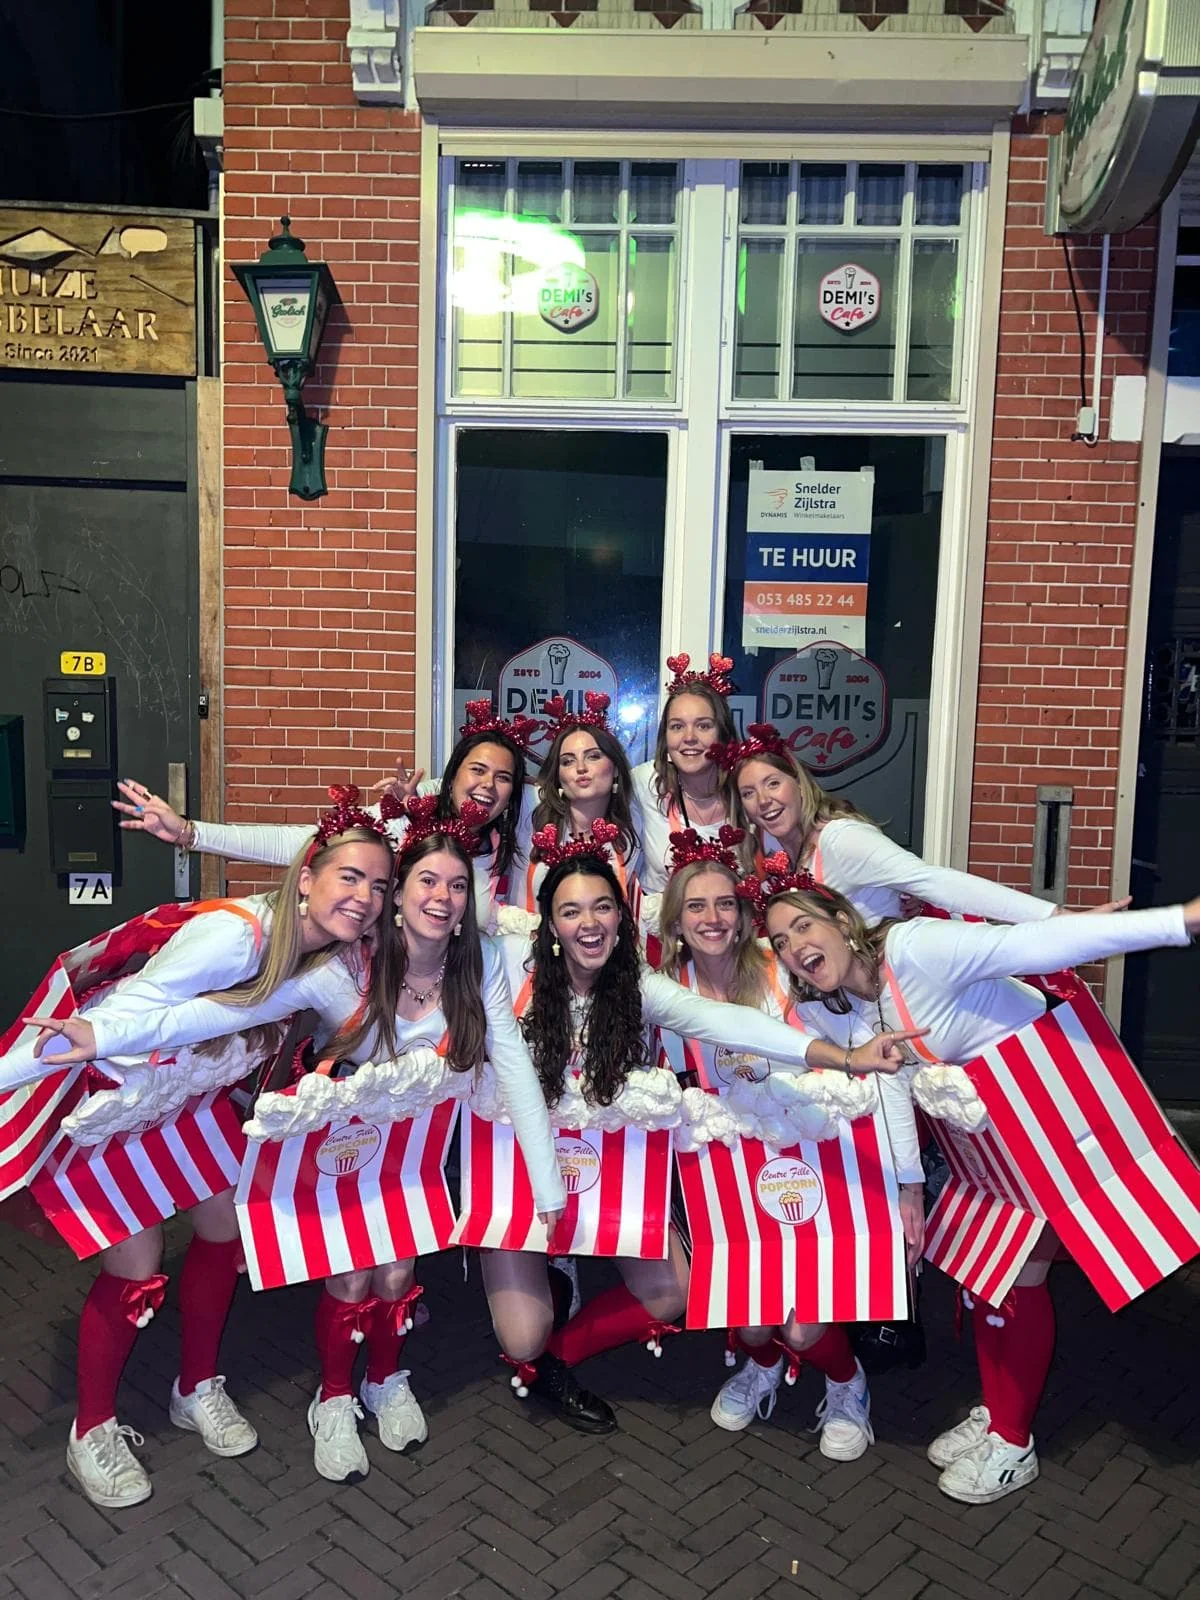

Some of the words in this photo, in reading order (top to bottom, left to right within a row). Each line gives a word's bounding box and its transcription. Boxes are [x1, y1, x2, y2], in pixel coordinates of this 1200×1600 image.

[541, 288, 593, 303] DEMI's
[823, 290, 875, 305] DEMI's
[0, 302, 159, 340] BELAAR
[4, 342, 54, 361] Since
[58, 344, 99, 363] 2021
[794, 482, 842, 495] Snelder
[794, 497, 836, 512] Zijlstra
[758, 547, 786, 567] TE
[791, 547, 857, 568] HUUR
[756, 593, 783, 606] 053
[786, 593, 812, 606] 485
[816, 594, 833, 606] 22
[837, 594, 855, 607] 44
[755, 624, 828, 636] snelderzijlstra.nl
[72, 656, 94, 672] 7B
[513, 668, 541, 678] ESTD
[771, 693, 876, 721] DEMI's
[74, 878, 109, 900] 7A
[320, 1135, 378, 1156] POPCORN
[573, 1146, 594, 1156] Fille
[557, 1156, 597, 1167] PCORN
[761, 1169, 788, 1181] Centre
[790, 1166, 810, 1179] Fille
[760, 1178, 817, 1193] POPCORN
